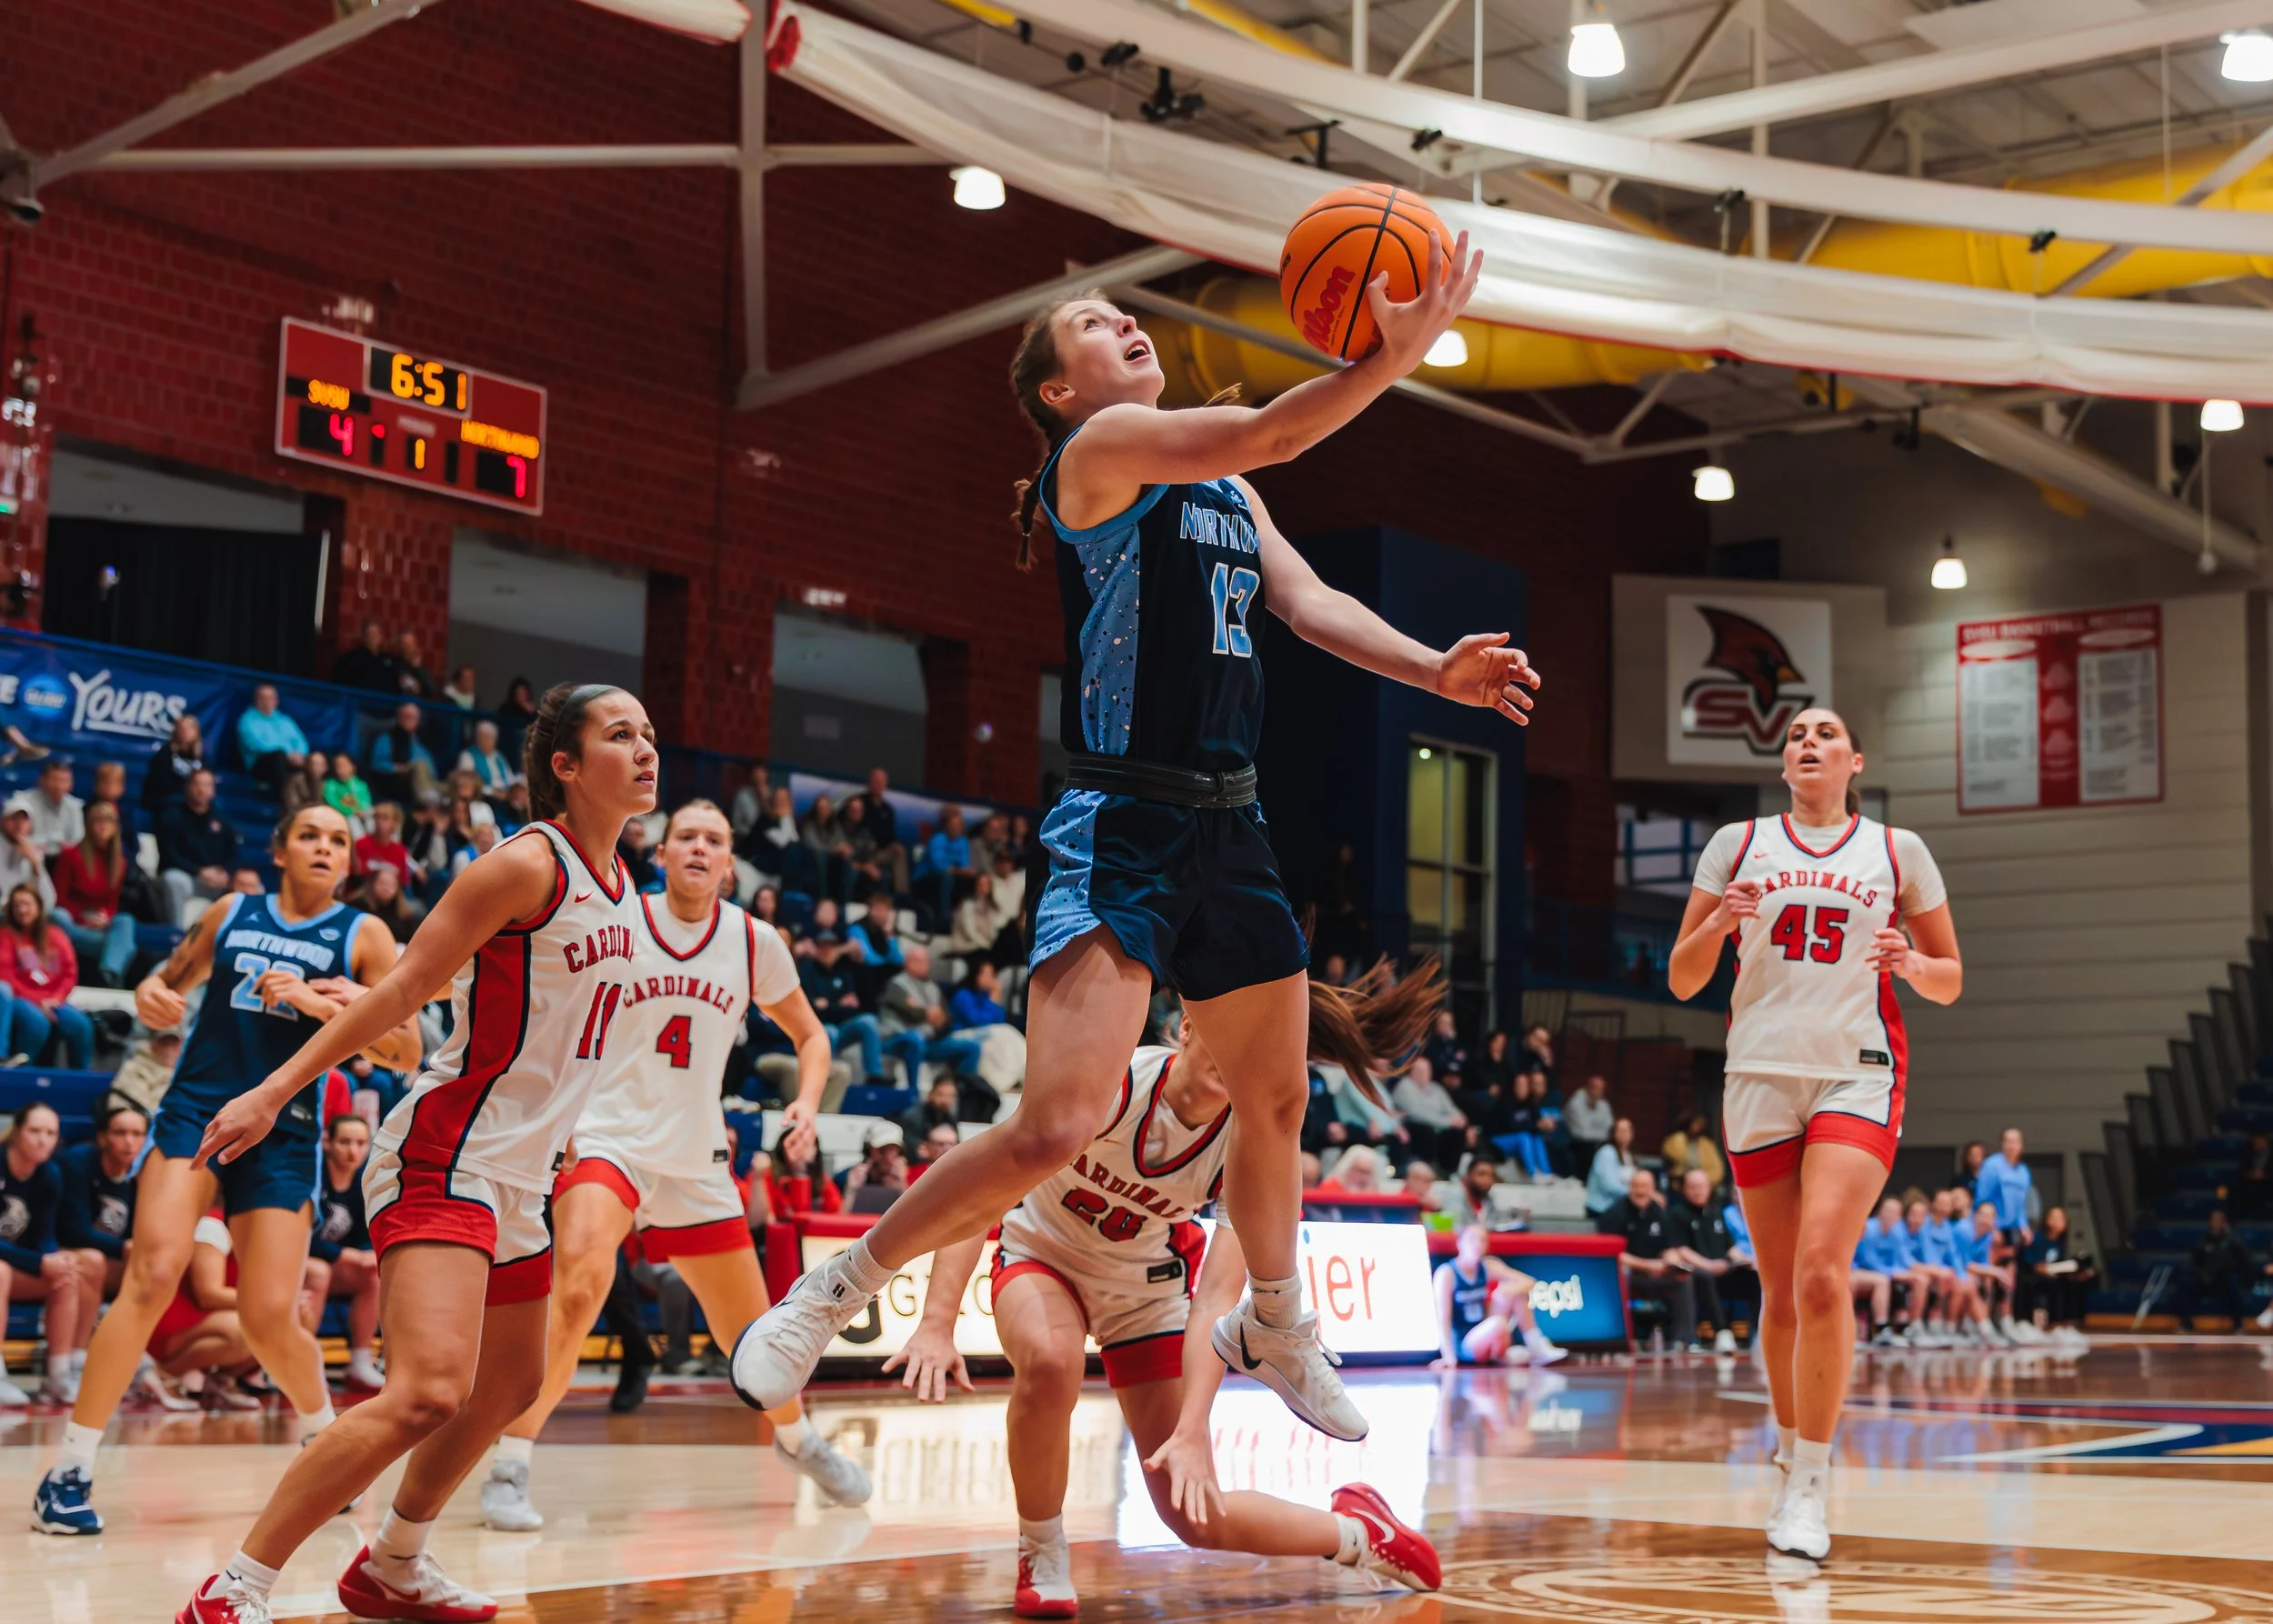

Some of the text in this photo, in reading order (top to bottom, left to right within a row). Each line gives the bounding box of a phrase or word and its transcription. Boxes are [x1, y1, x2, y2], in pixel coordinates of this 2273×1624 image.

[391, 354, 466, 410] 6:51
[330, 413, 353, 456] 4
[415, 438, 426, 469] 1
[506, 456, 526, 498] 7
[1210, 562, 1261, 657] 13
[68, 669, 187, 731] YOURS
[1682, 678, 1815, 756] SV
[1759, 870, 1877, 908] ARDINALS
[1771, 904, 1849, 964] 45
[576, 981, 623, 1061] 11
[622, 976, 735, 1015] CARDINALS
[656, 1015, 692, 1069] 4
[1528, 1274, 1584, 1318] epsi
